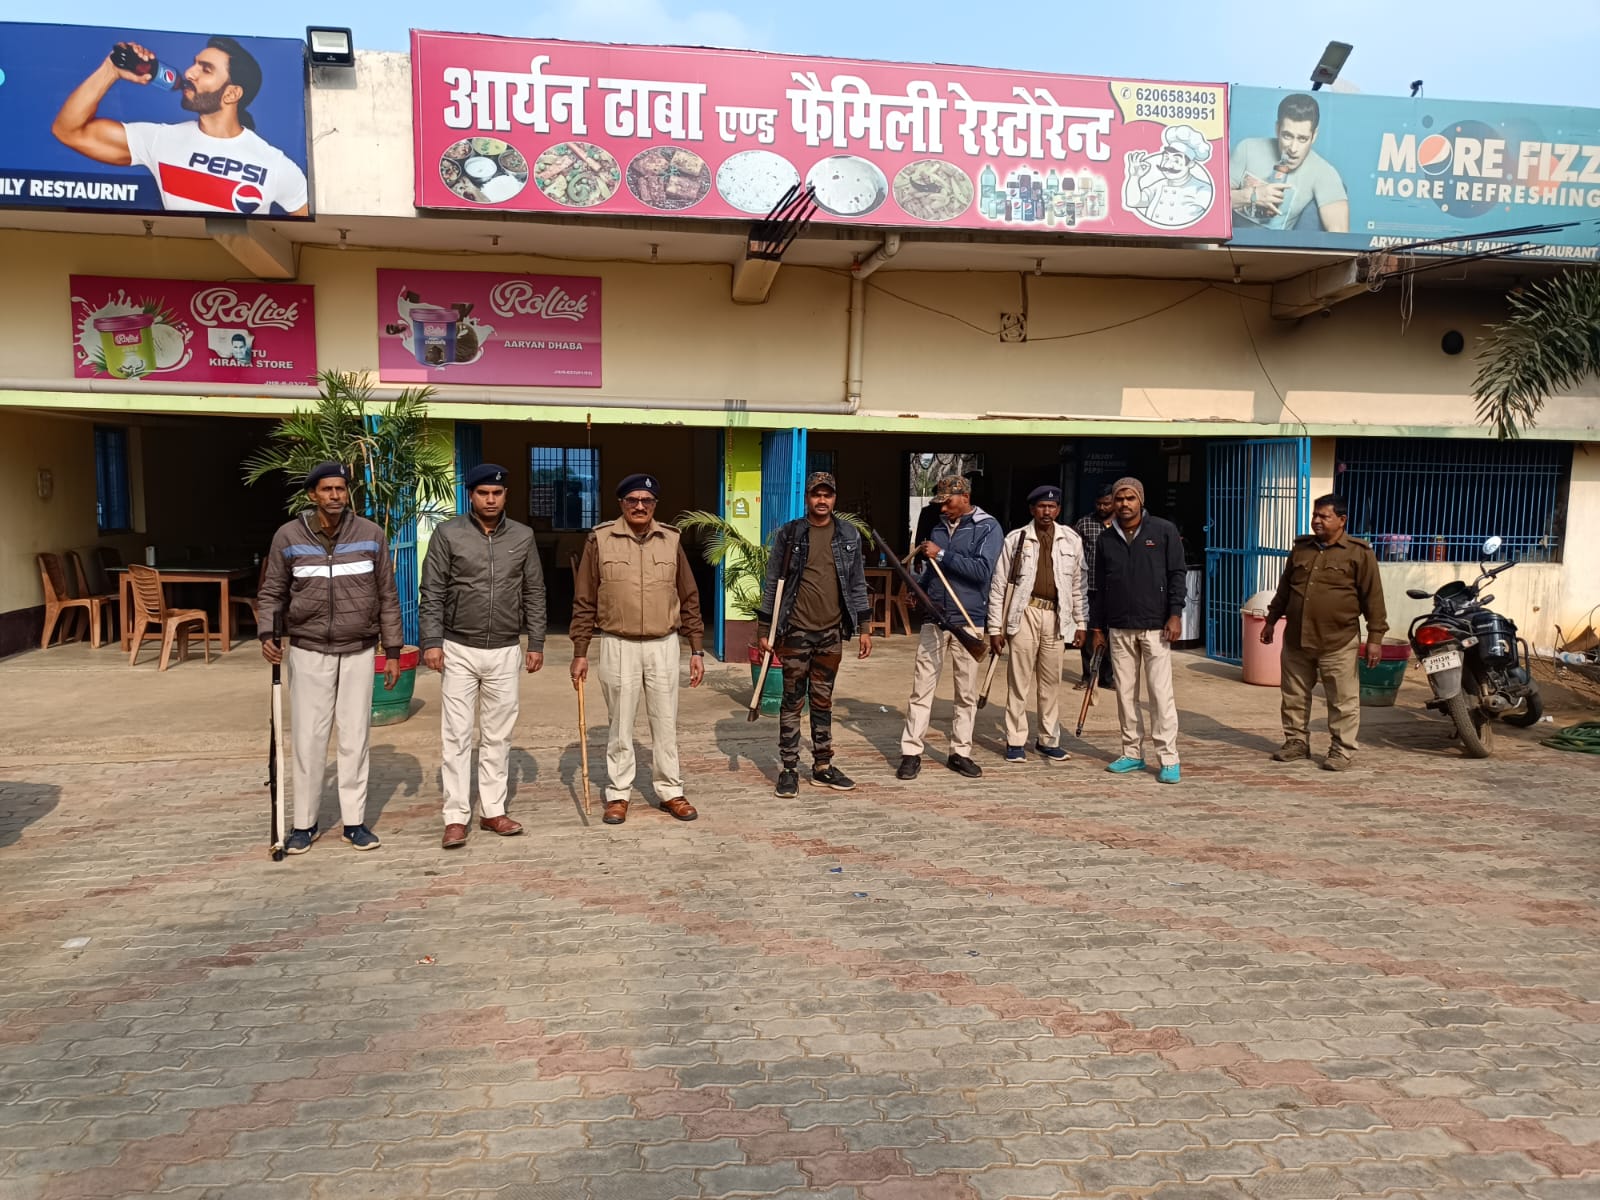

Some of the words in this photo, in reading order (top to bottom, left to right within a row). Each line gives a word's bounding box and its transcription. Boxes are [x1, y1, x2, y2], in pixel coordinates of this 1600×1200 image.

[443, 55, 590, 135] आर्यन
[597, 78, 707, 141] ढाबा
[714, 105, 779, 144] एण्ड
[785, 72, 948, 153] फैमिली
[947, 82, 1115, 161] रेस्टोरेन्ट
[1136, 88, 1216, 105] 6206583403
[1136, 104, 1216, 121] 8340389951
[189, 152, 269, 186] PEPSI
[1517, 141, 1600, 184] FIZZ
[30, 179, 139, 202] RESTAURNT
[1375, 177, 1445, 200] MORE
[1455, 181, 1600, 208] REFRESHING
[1520, 243, 1599, 258] RESTAURANT
[190, 287, 300, 330] Rollick
[489, 280, 589, 322] Rollick
[504, 339, 546, 349] AARYAN
[548, 341, 583, 351] DHABA
[255, 360, 294, 369] STORE
